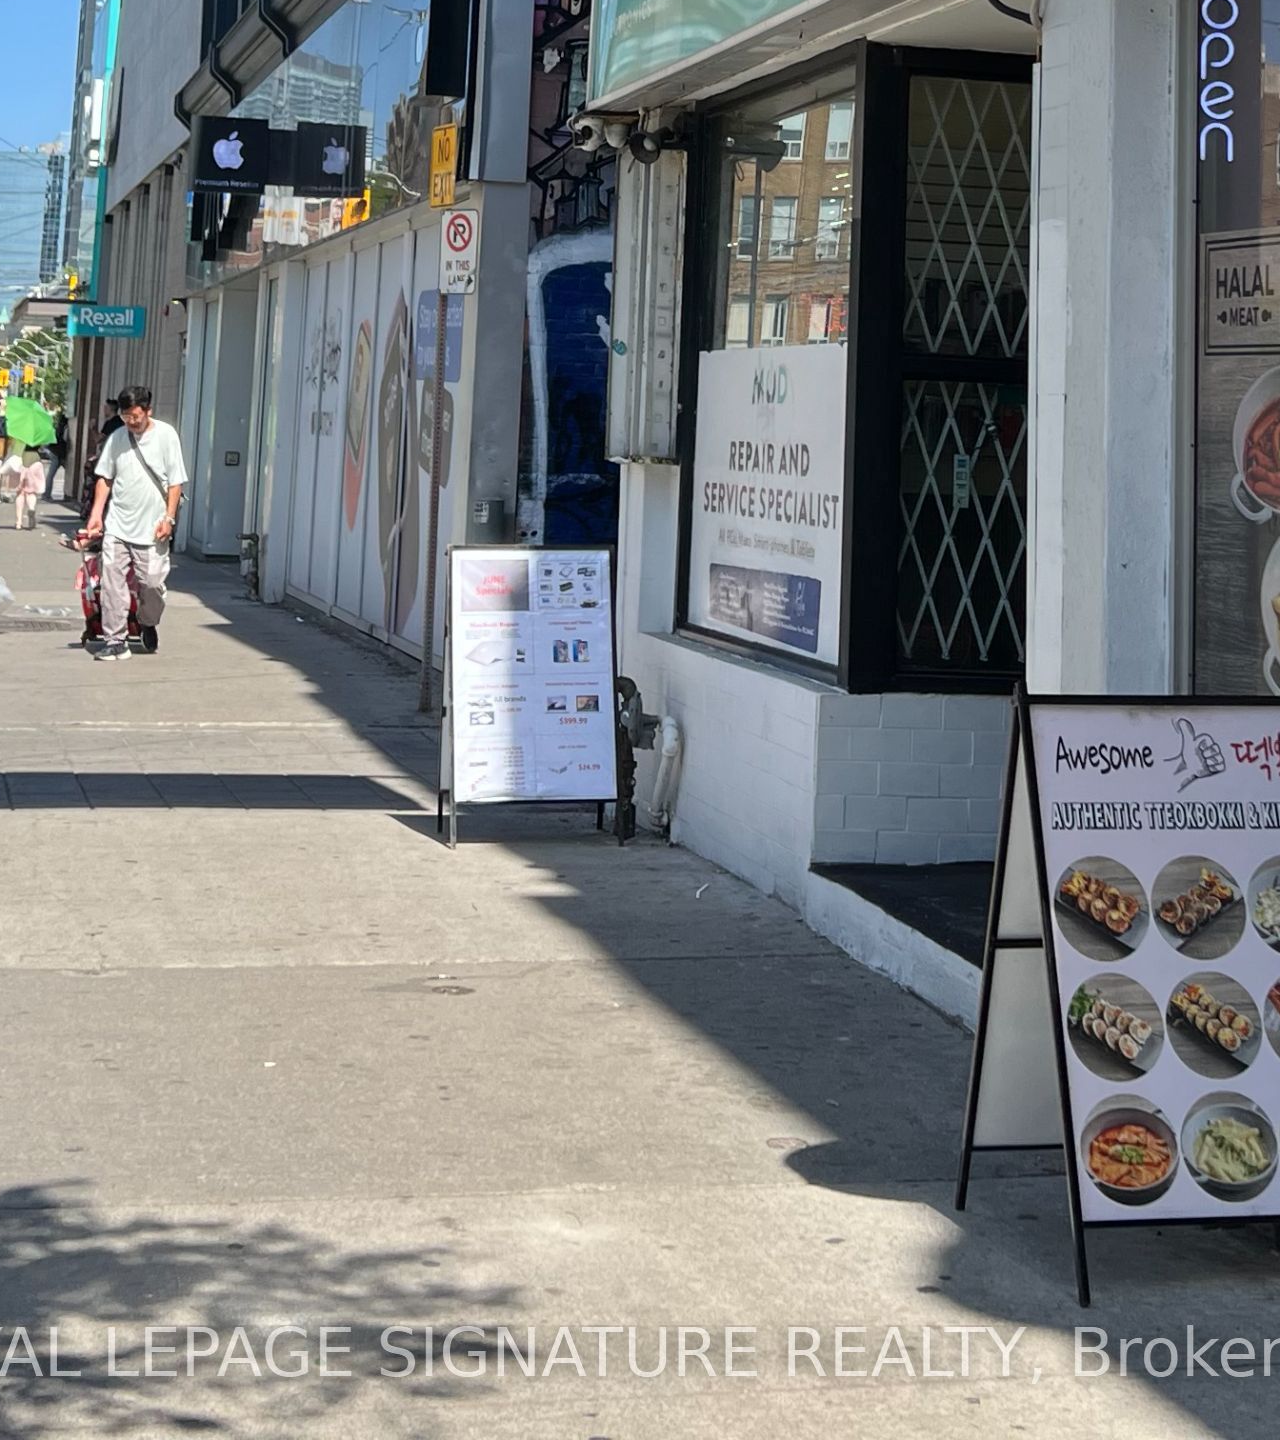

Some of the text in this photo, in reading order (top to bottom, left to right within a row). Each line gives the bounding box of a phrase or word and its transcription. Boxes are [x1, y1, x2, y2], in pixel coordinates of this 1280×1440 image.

[438, 138, 451, 163] NO
[433, 173, 453, 198] EXIT
[445, 260, 469, 271] IN THIS
[1216, 264, 1275, 299] HALAL
[80, 308, 134, 327] Rexall
[1229, 306, 1260, 327] MEAT
[729, 441, 810, 477] REPAIR AND
[704, 481, 839, 529] SERVICE SPECIALIST
[1055, 735, 1154, 775] Awesome
[1052, 801, 1142, 830] AUTHENTIC
[1144, 801, 1246, 830] TTEOKBOKKI
[1247, 801, 1262, 830] &
